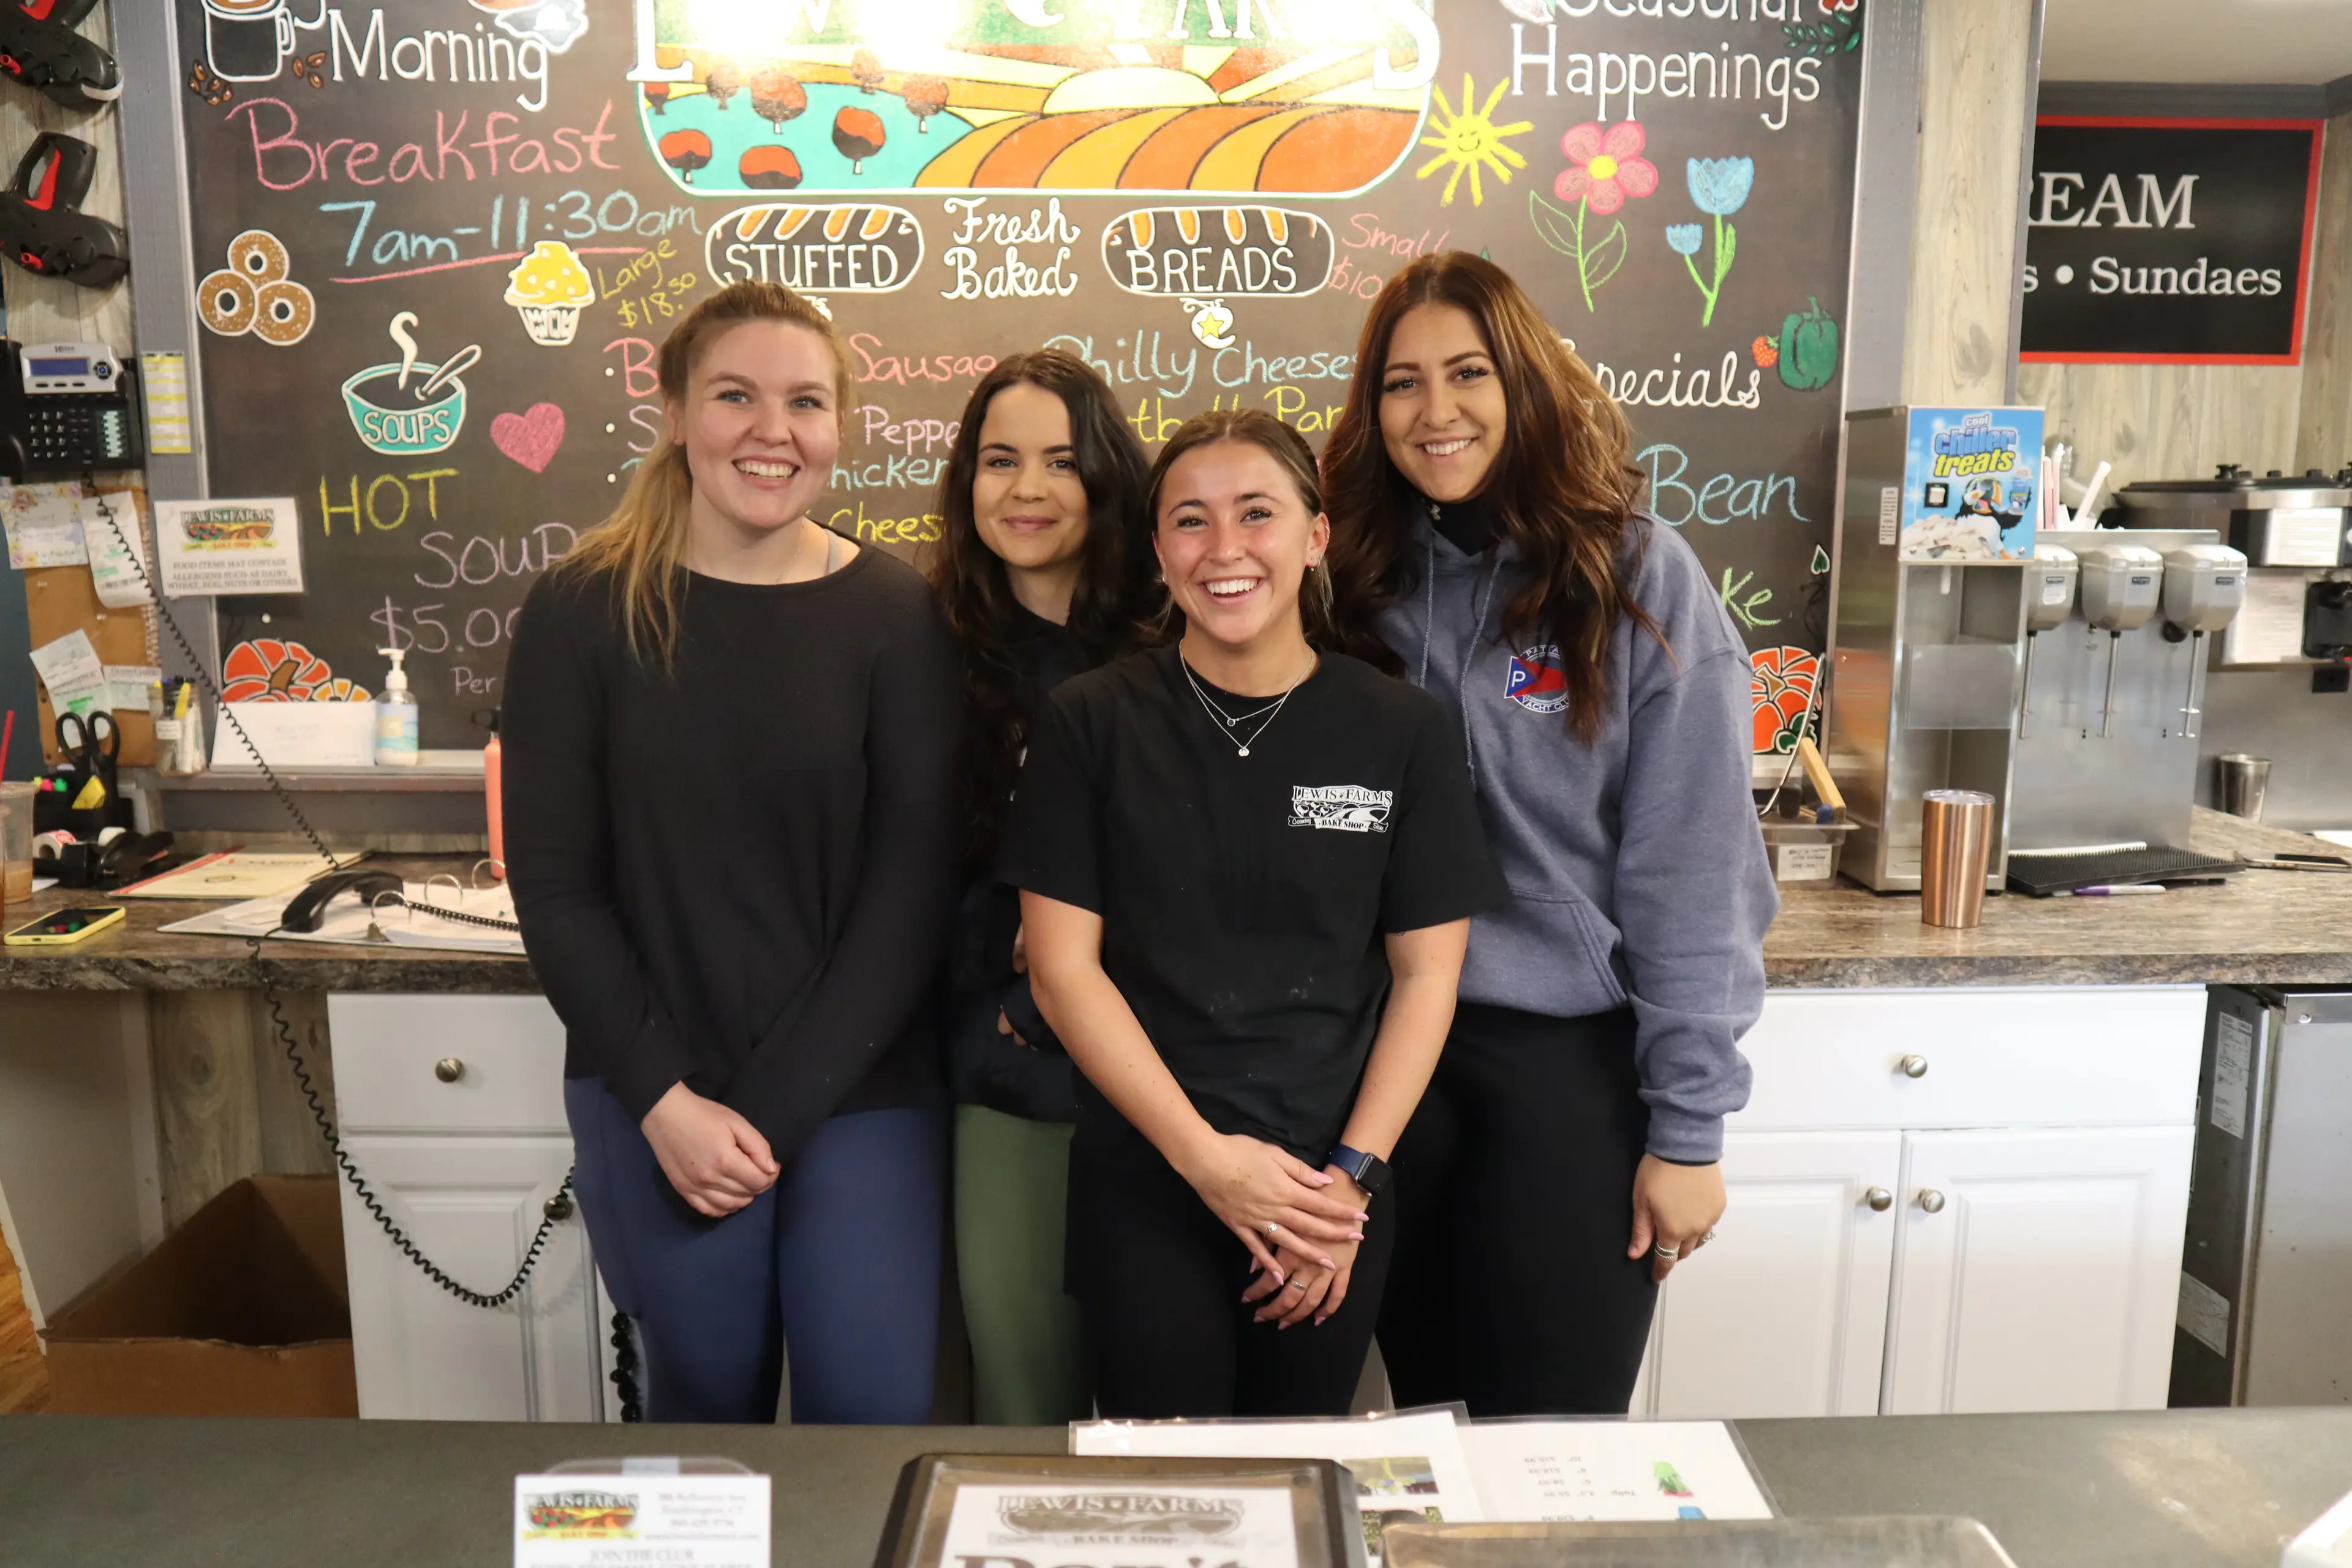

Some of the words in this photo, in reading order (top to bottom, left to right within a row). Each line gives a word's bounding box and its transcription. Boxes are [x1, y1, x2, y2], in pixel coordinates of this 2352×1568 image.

[328, 8, 548, 111] Morning
[1511, 22, 1822, 130] Happenings
[225, 97, 620, 190] Breakfast
[944, 197, 1080, 245] Fresh
[1341, 213, 1450, 260] Small
[598, 239, 677, 300] Large
[725, 244, 898, 288] STUFFED
[941, 246, 1079, 300] Baked
[1128, 247, 1297, 293] BREADS
[2089, 256, 2282, 296] Sundaes
[1213, 340, 1357, 388] Cheese
[1596, 351, 1760, 409] pecials
[363, 409, 451, 445] SOUPS
[1965, 414, 1989, 428] cool
[1934, 426, 2017, 456] chiller
[1933, 448, 2016, 478] treats
[319, 468, 459, 537] HOT
[1637, 443, 1812, 527] Bean
[230, 508, 275, 522] FARMS
[198, 560, 225, 569] ITEMS
[414, 522, 579, 589] SOUP
[172, 571, 222, 581] ALLERGENS
[223, 570, 247, 579] SUCH
[262, 578, 298, 587] OTHERS
[449, 666, 498, 695] Per
[1511, 671, 1526, 687] P
[1521, 697, 1552, 712] YACHT
[1292, 785, 1337, 801] LEWIS
[1346, 787, 1393, 807] FARMS
[1322, 818, 1343, 827] BAKE
[1344, 821, 1363, 829] SHOP
[995, 1494, 1114, 1515] LEWIS
[1128, 1494, 1246, 1518] FARMS
[590, 1549, 624, 1564] JOIN
[626, 1549, 651, 1561] THE
[655, 1549, 695, 1561] CLUB
